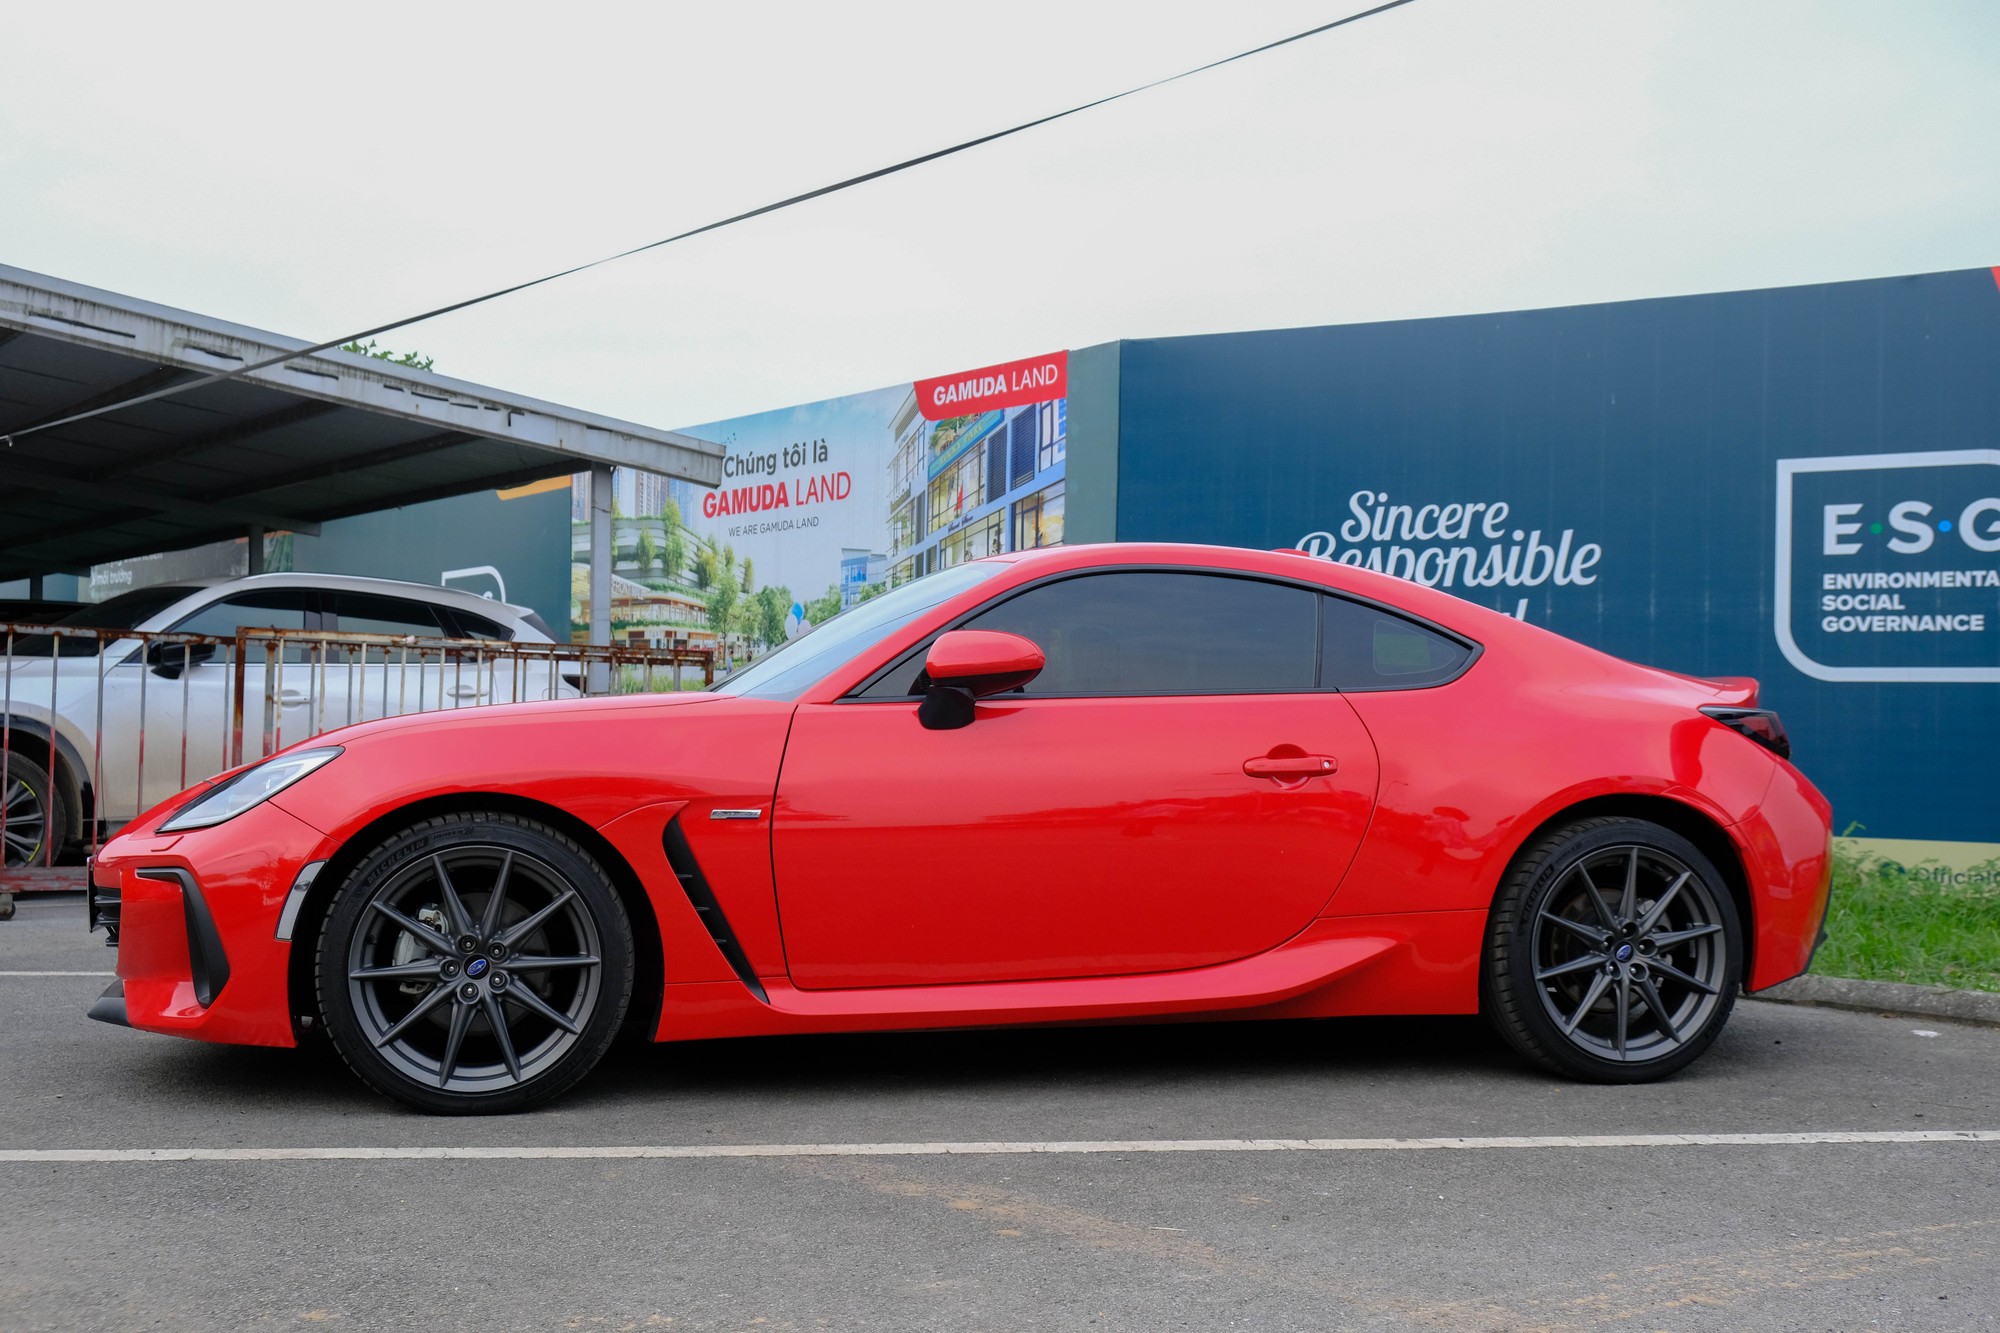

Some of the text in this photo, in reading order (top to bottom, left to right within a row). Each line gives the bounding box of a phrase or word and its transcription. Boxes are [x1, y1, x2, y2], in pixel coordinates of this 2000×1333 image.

[933, 364, 1059, 406] GAMUDA LAND
[723, 438, 828, 478] Chúng tôi là
[703, 471, 851, 518] GAMUDA LAND
[728, 516, 819, 537] WE ARE GAMUDA LAND
[1340, 490, 1509, 543] Sincere
[1822, 570, 2000, 590] ENVIRONMENTA
[1821, 594, 1906, 611] SOCIAL
[1821, 614, 1985, 632] GOVERNANCE
[366, 838, 426, 885] MICHELIN
